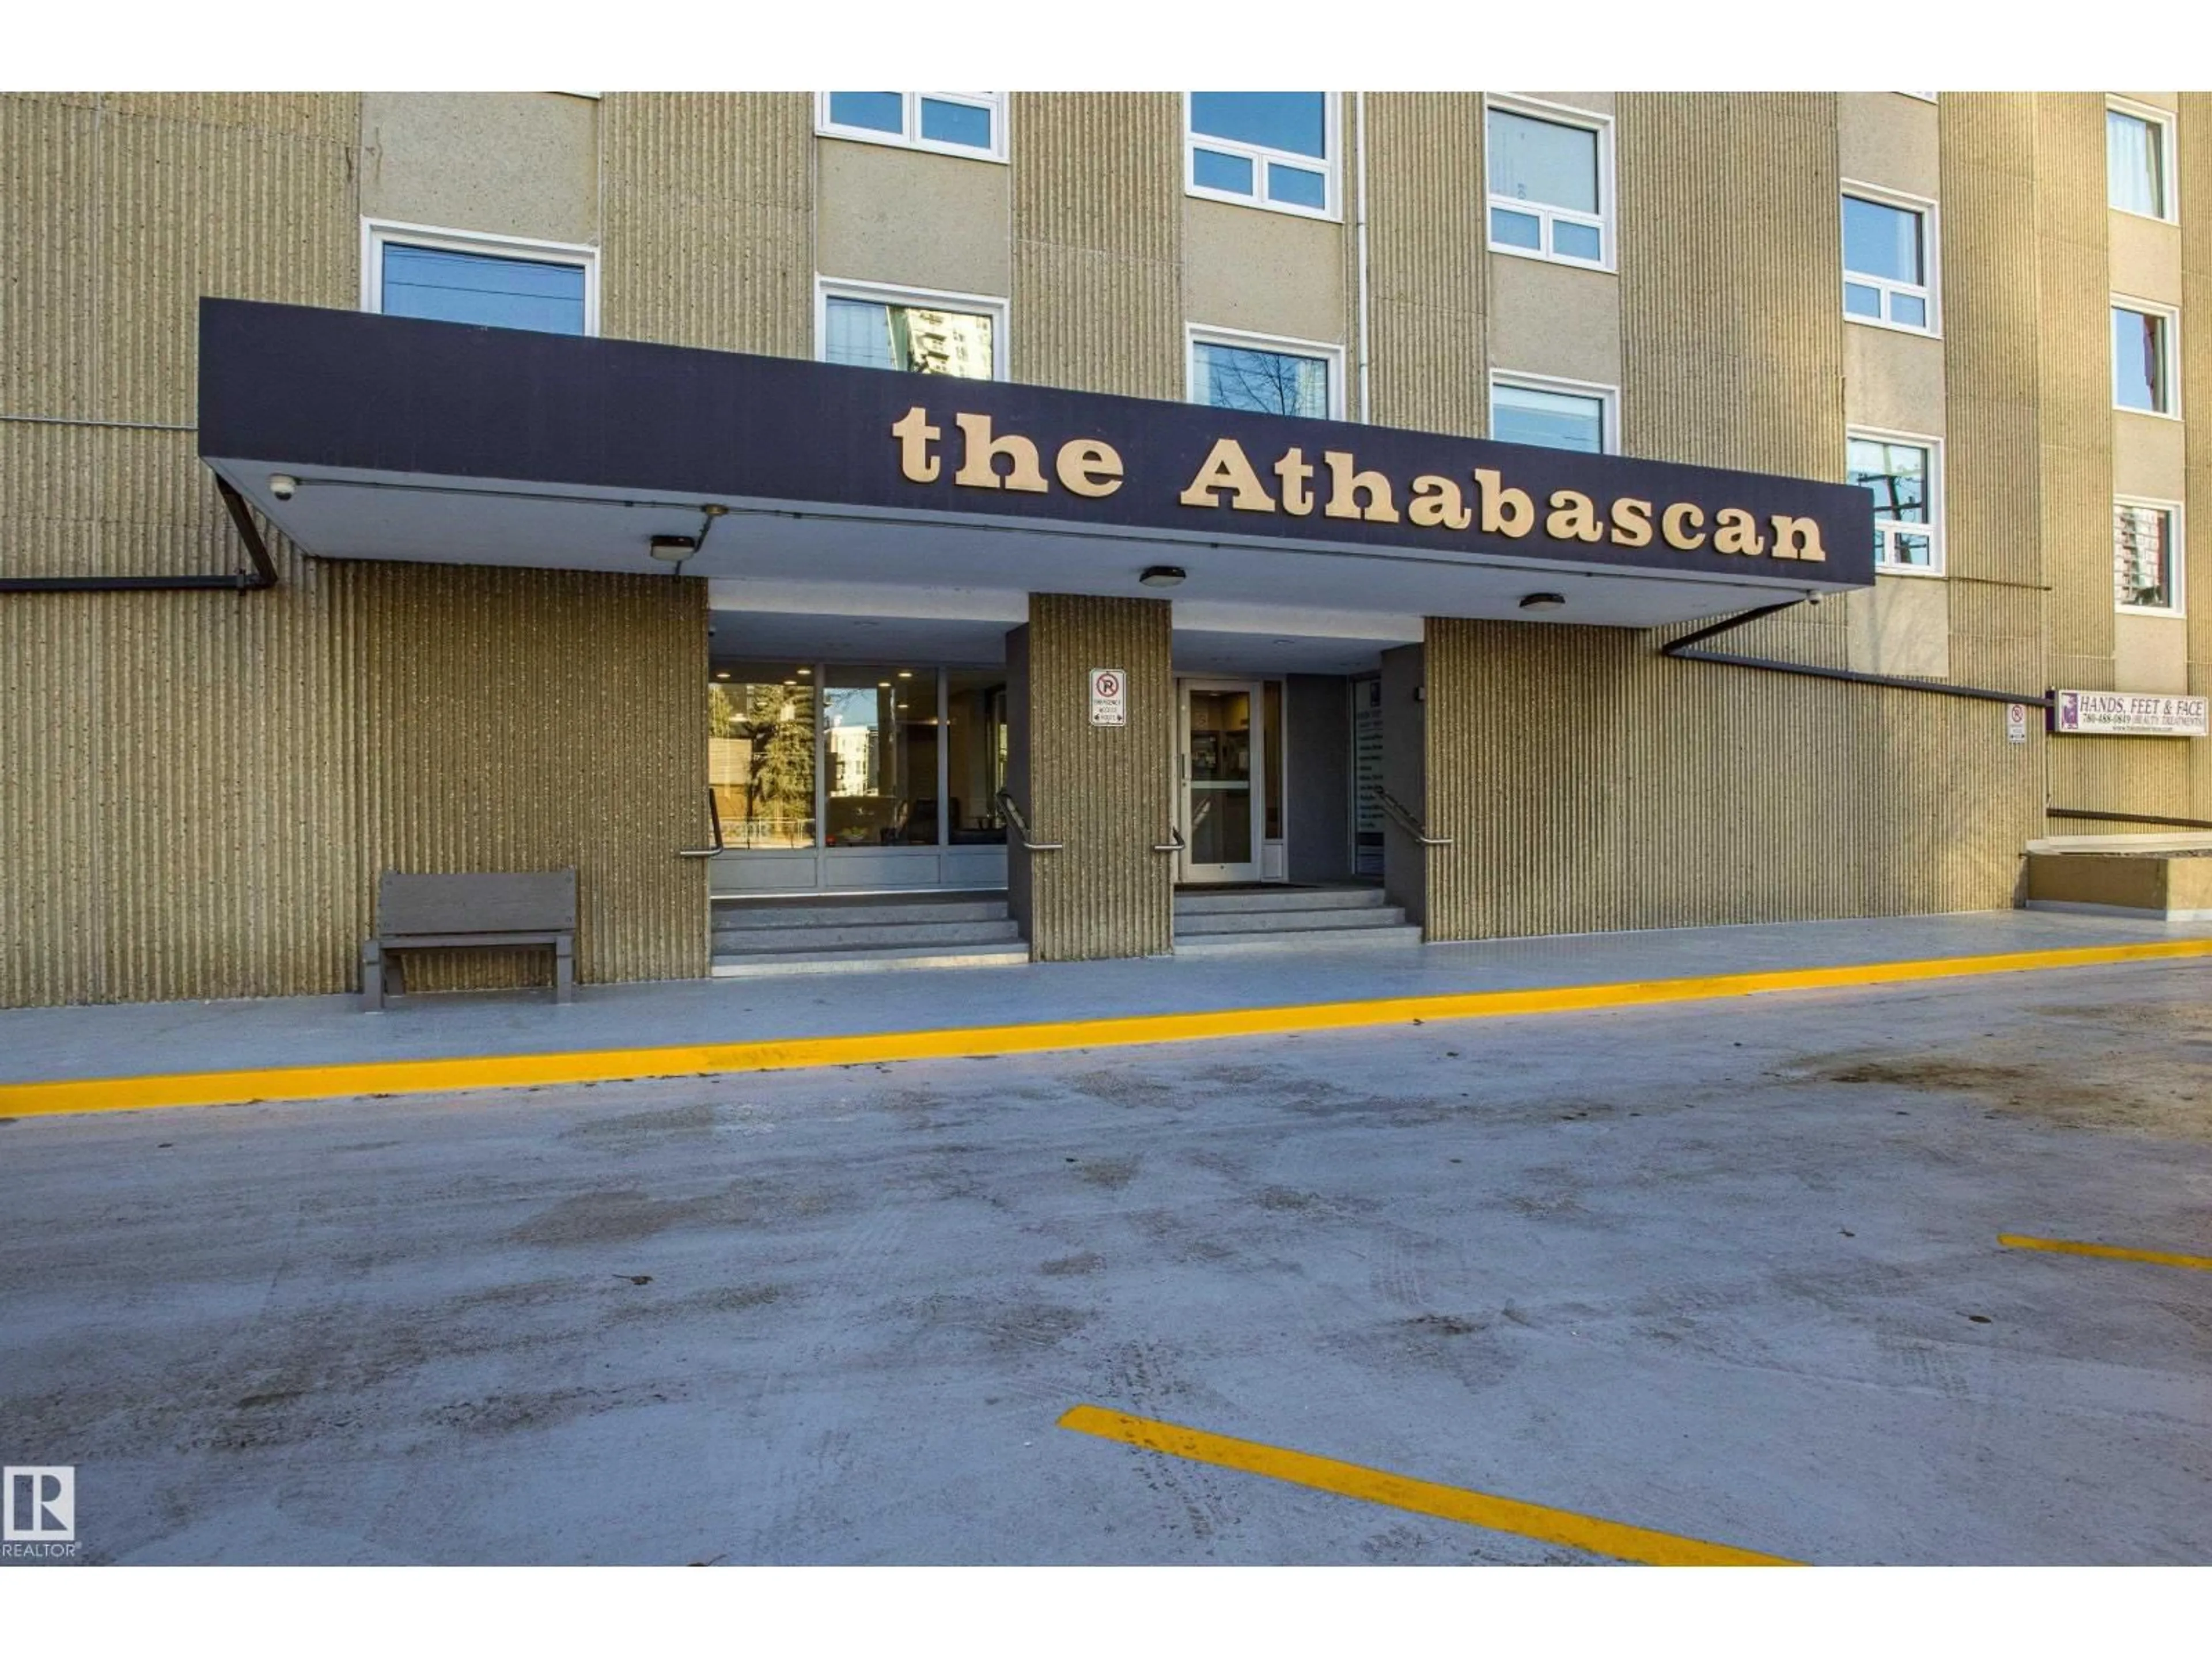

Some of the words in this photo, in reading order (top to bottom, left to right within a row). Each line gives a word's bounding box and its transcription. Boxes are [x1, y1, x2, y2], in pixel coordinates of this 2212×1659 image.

[892, 407, 1124, 498] the
[1180, 438, 1826, 562] Athabascan
[2080, 695, 2126, 714] HANDS,
[2131, 698, 2160, 714] FEET
[2164, 699, 2172, 715] &
[2177, 700, 2203, 715] FACE
